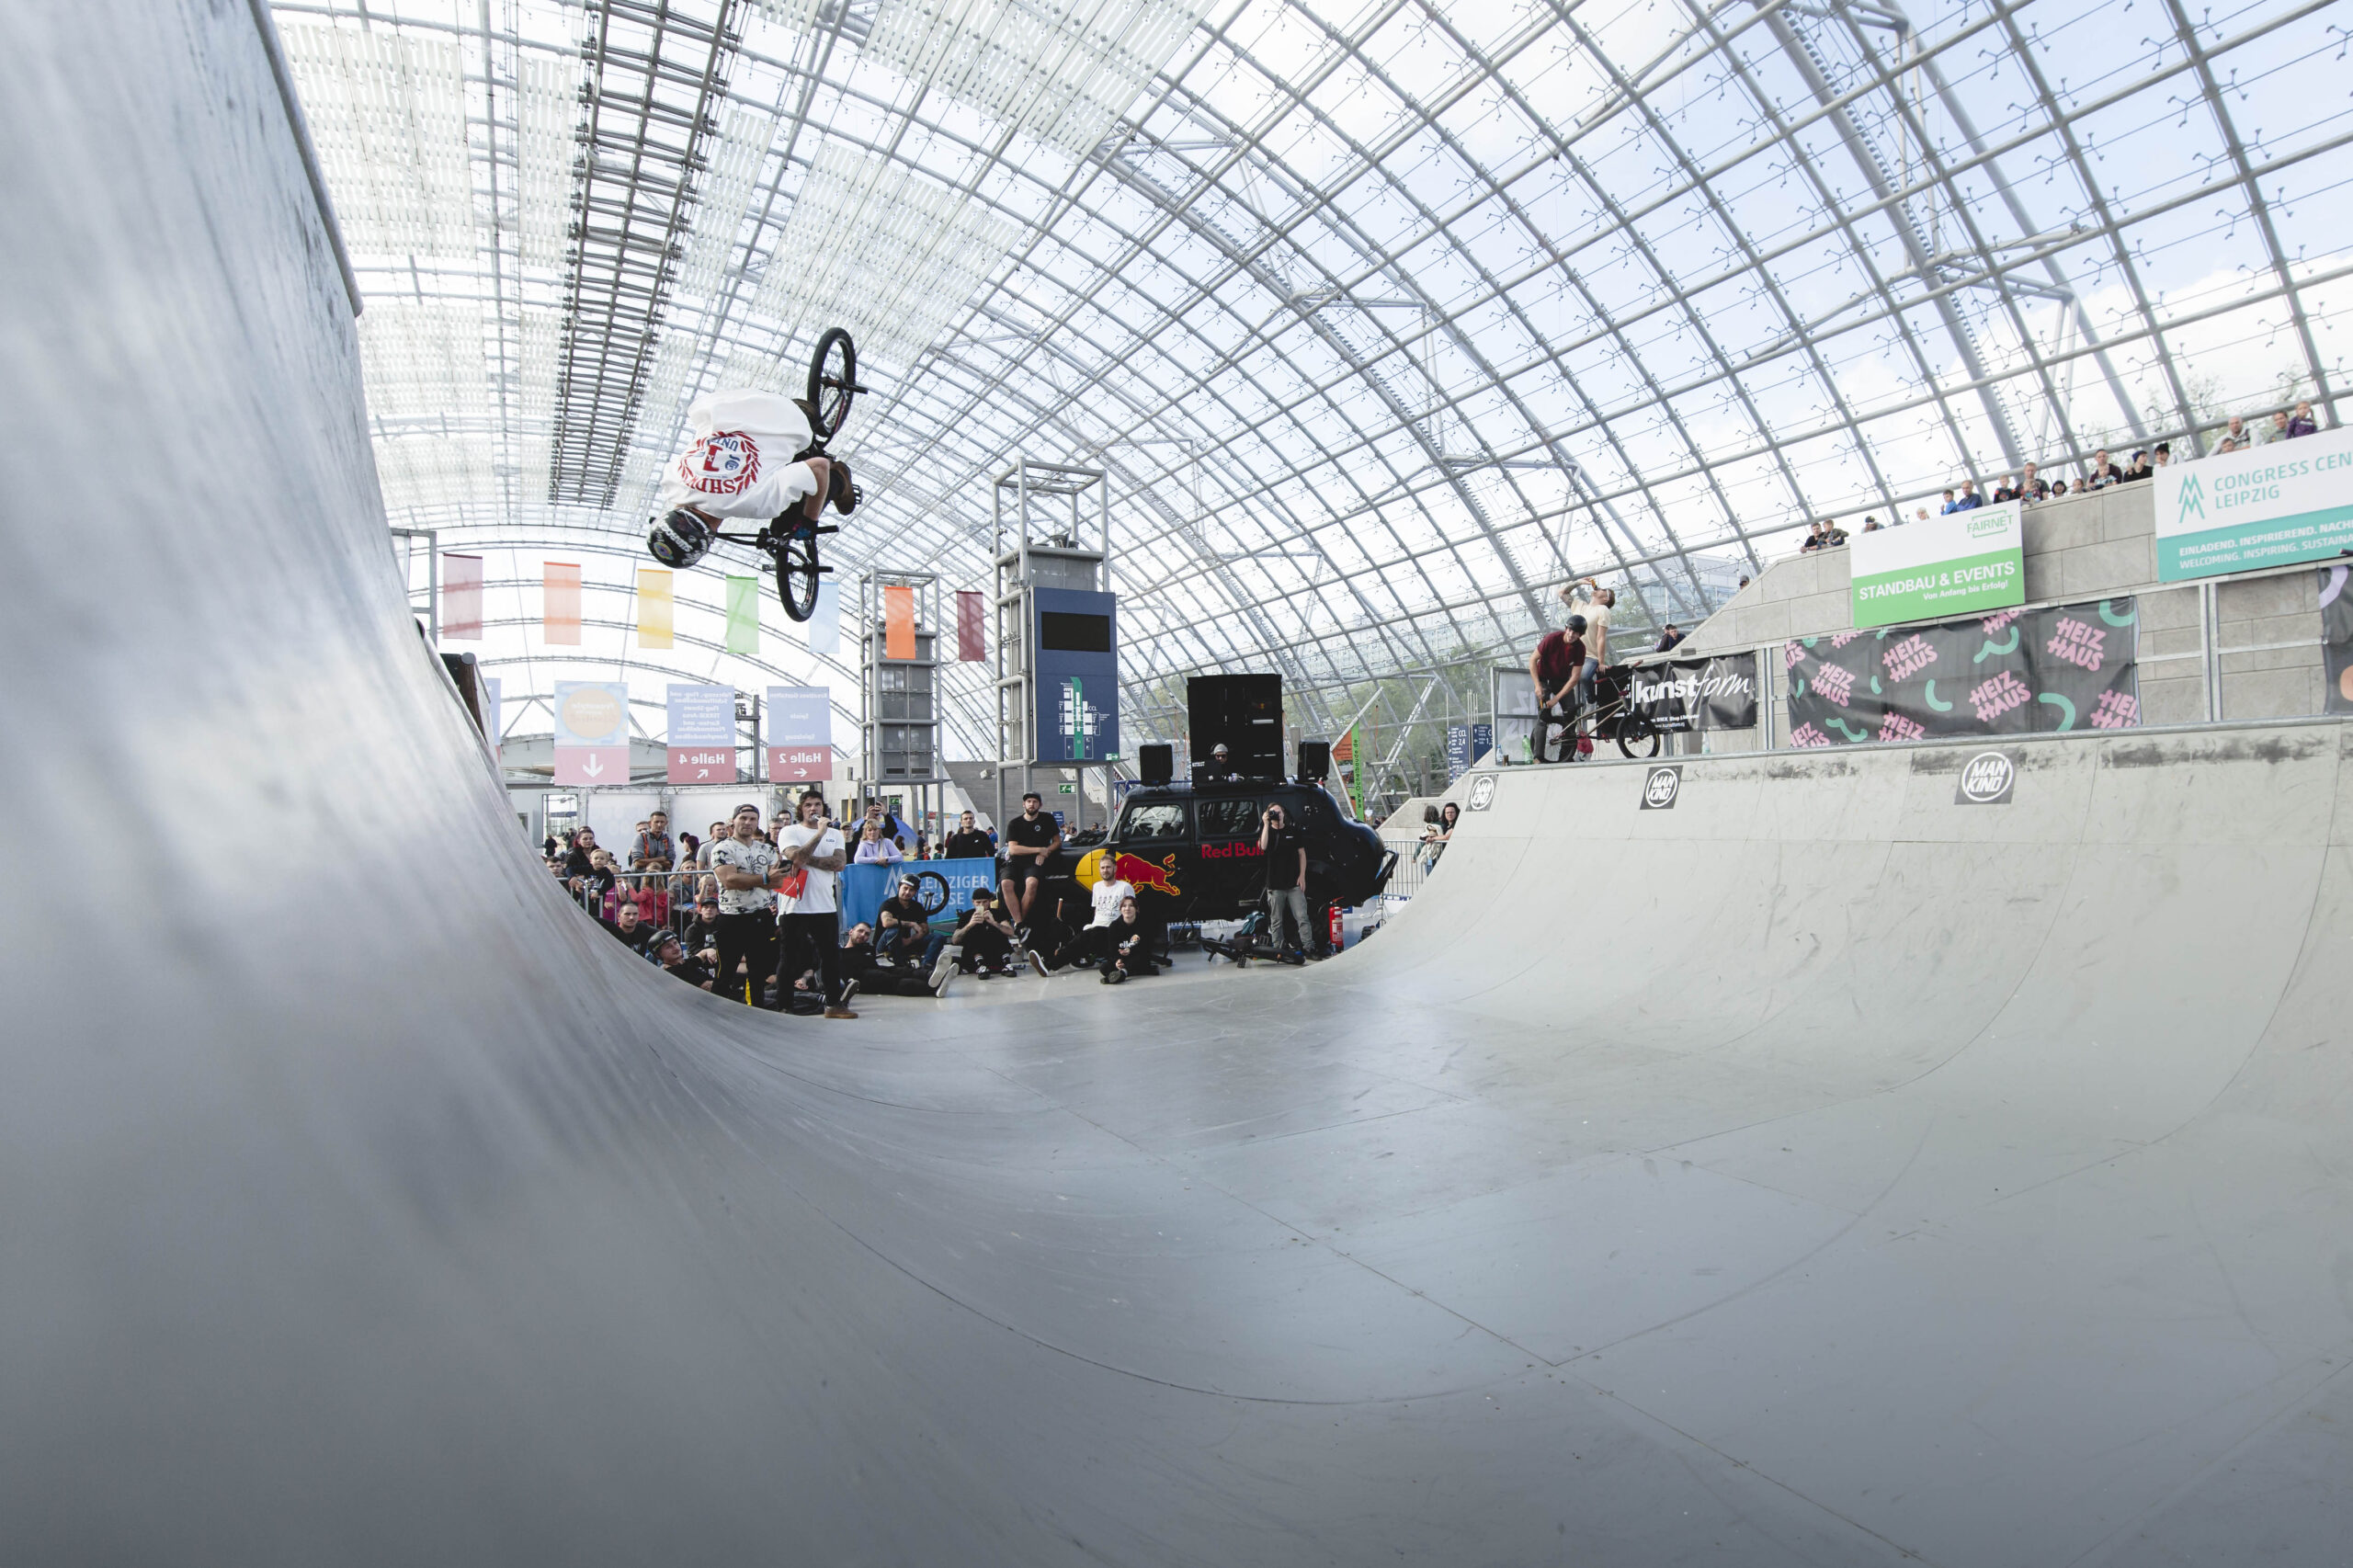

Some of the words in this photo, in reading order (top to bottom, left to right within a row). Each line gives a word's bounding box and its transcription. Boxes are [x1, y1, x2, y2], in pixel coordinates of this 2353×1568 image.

[2214, 460, 2310, 492] CONGRESS
[2315, 450, 2353, 472] CEN
[2215, 484, 2280, 509] LEIPZIG
[1967, 515, 2014, 533] FAIRNET
[2179, 539, 2238, 557] EINLADEND.
[2239, 526, 2318, 547] INSPIRIEREND.
[2319, 519, 2353, 534] NACH
[2179, 551, 2242, 569] WELCOMING.
[2244, 542, 2300, 559] INSPIRING.
[1859, 574, 1936, 600] STANDBAU
[1939, 573, 1950, 586] &
[1954, 561, 2016, 585] EVENTS
[1923, 592, 1938, 600] Von
[1939, 586, 1967, 598] Anfang
[1968, 584, 1980, 593] bis
[1982, 580, 2008, 591] Erfolg!
[2055, 617, 2108, 652] HEIZ
[1882, 633, 1927, 668] HEIZ
[1889, 644, 1938, 683] HAUS
[2047, 636, 2105, 672] HAUS
[1635, 664, 1750, 709] kunstform
[1811, 676, 1851, 707] HAUS
[1819, 662, 1856, 691] HEIZ
[1969, 670, 2019, 707] HEIZ
[1976, 683, 2031, 722] HAUS
[1882, 710, 1926, 741] HEIZ
[1652, 775, 1676, 788] MAN
[1971, 758, 2009, 778] MAN
[1472, 793, 1490, 804] KIND
[1475, 782, 1493, 794] MAN
[1649, 788, 1671, 801] KIND
[1967, 777, 2004, 792] KIND
[1201, 842, 1232, 858] Red
